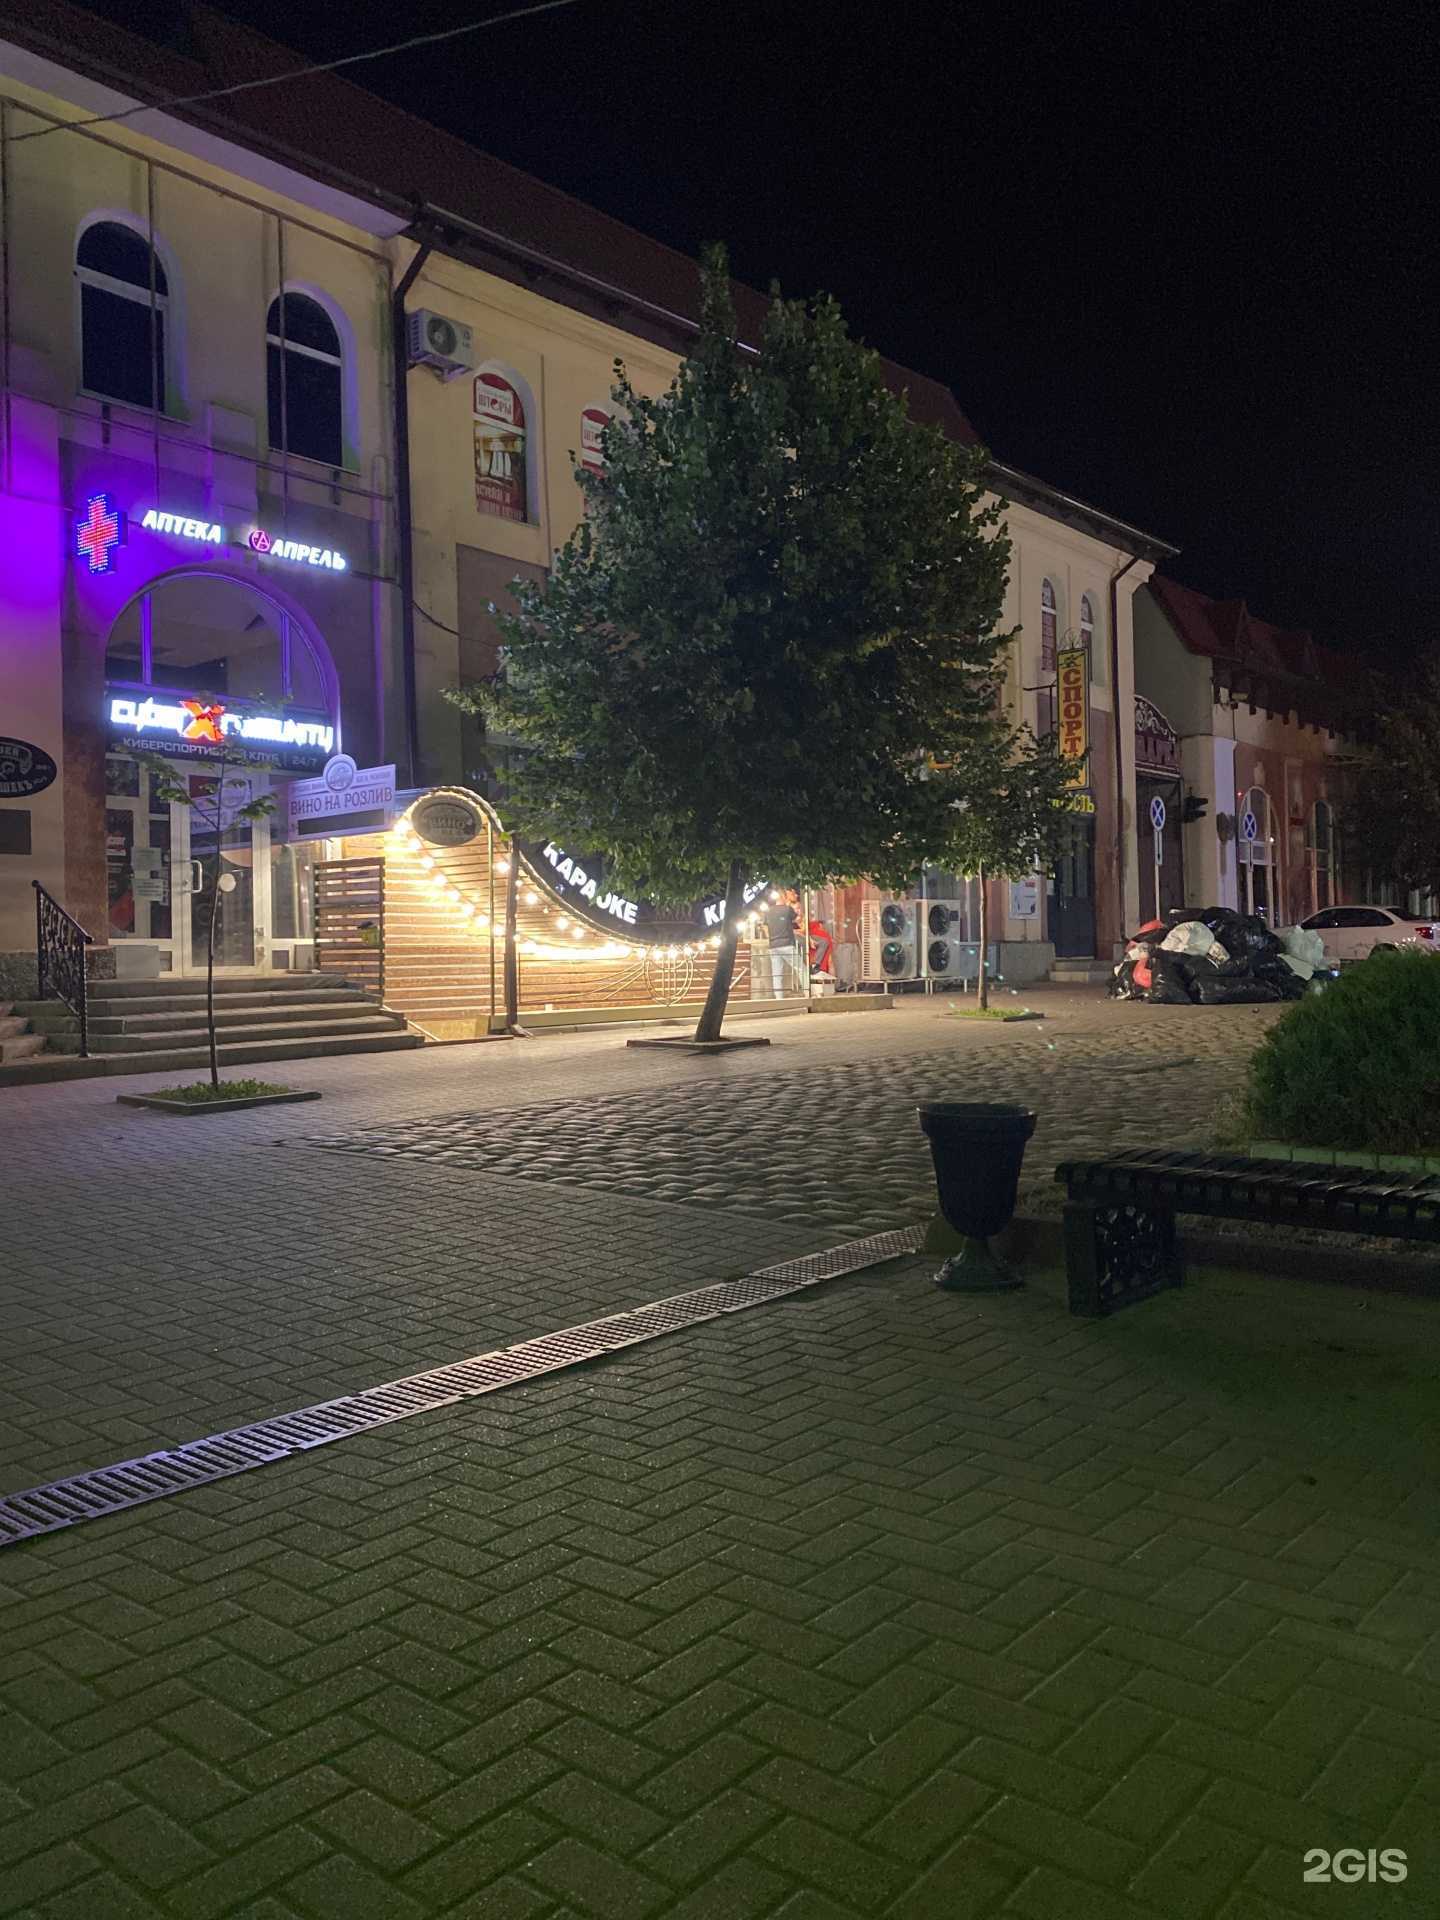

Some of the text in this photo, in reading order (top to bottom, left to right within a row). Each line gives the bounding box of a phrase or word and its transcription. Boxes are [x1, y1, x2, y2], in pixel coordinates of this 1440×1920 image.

[142, 509, 222, 544] АПТЕКА
[270, 538, 346, 570] АПРЕЛЬ
[1063, 669, 1083, 753] СПОРТ
[290, 797, 322, 815] ВИНО
[324, 794, 341, 811] НА
[344, 787, 393, 808] РОЗЛИВ
